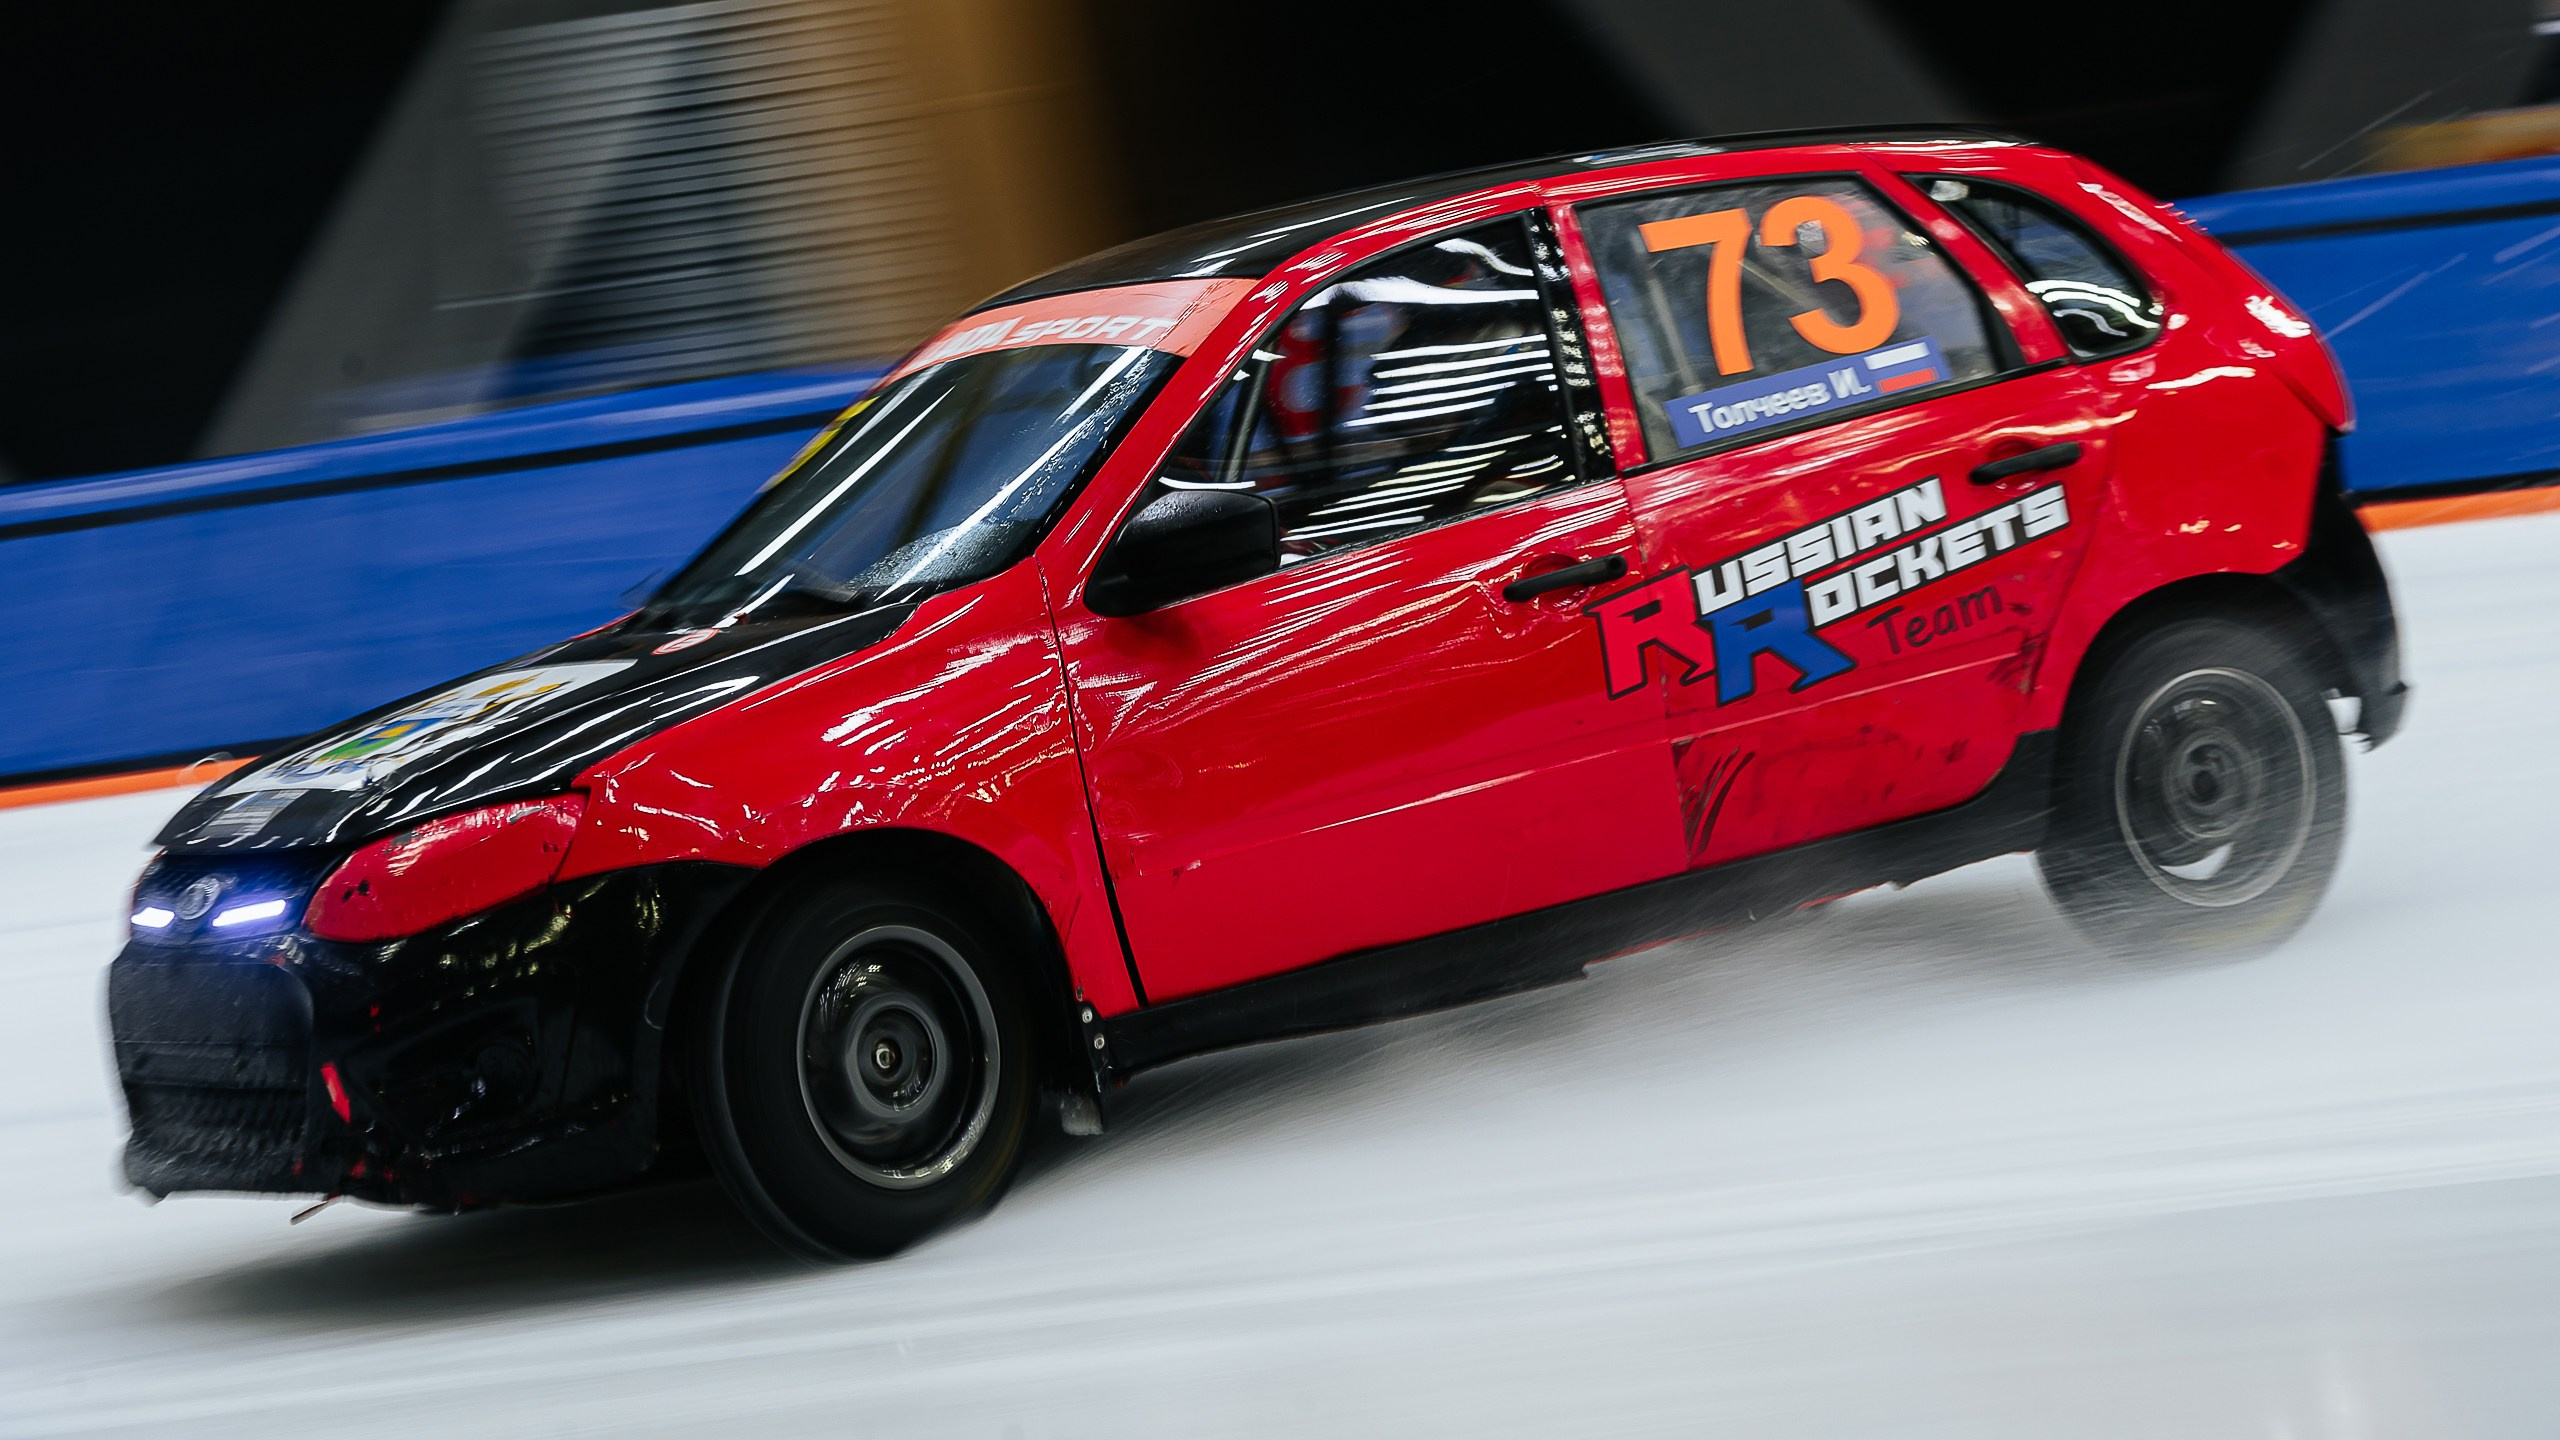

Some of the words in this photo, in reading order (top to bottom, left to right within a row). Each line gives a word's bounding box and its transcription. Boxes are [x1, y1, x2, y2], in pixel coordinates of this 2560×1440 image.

[1638, 196, 1900, 376] 73
[1001, 315, 1178, 343] SPORT
[1688, 382, 1831, 433] Толчеев
[1827, 367, 1872, 399] И.
[1866, 585, 2003, 654] Team
